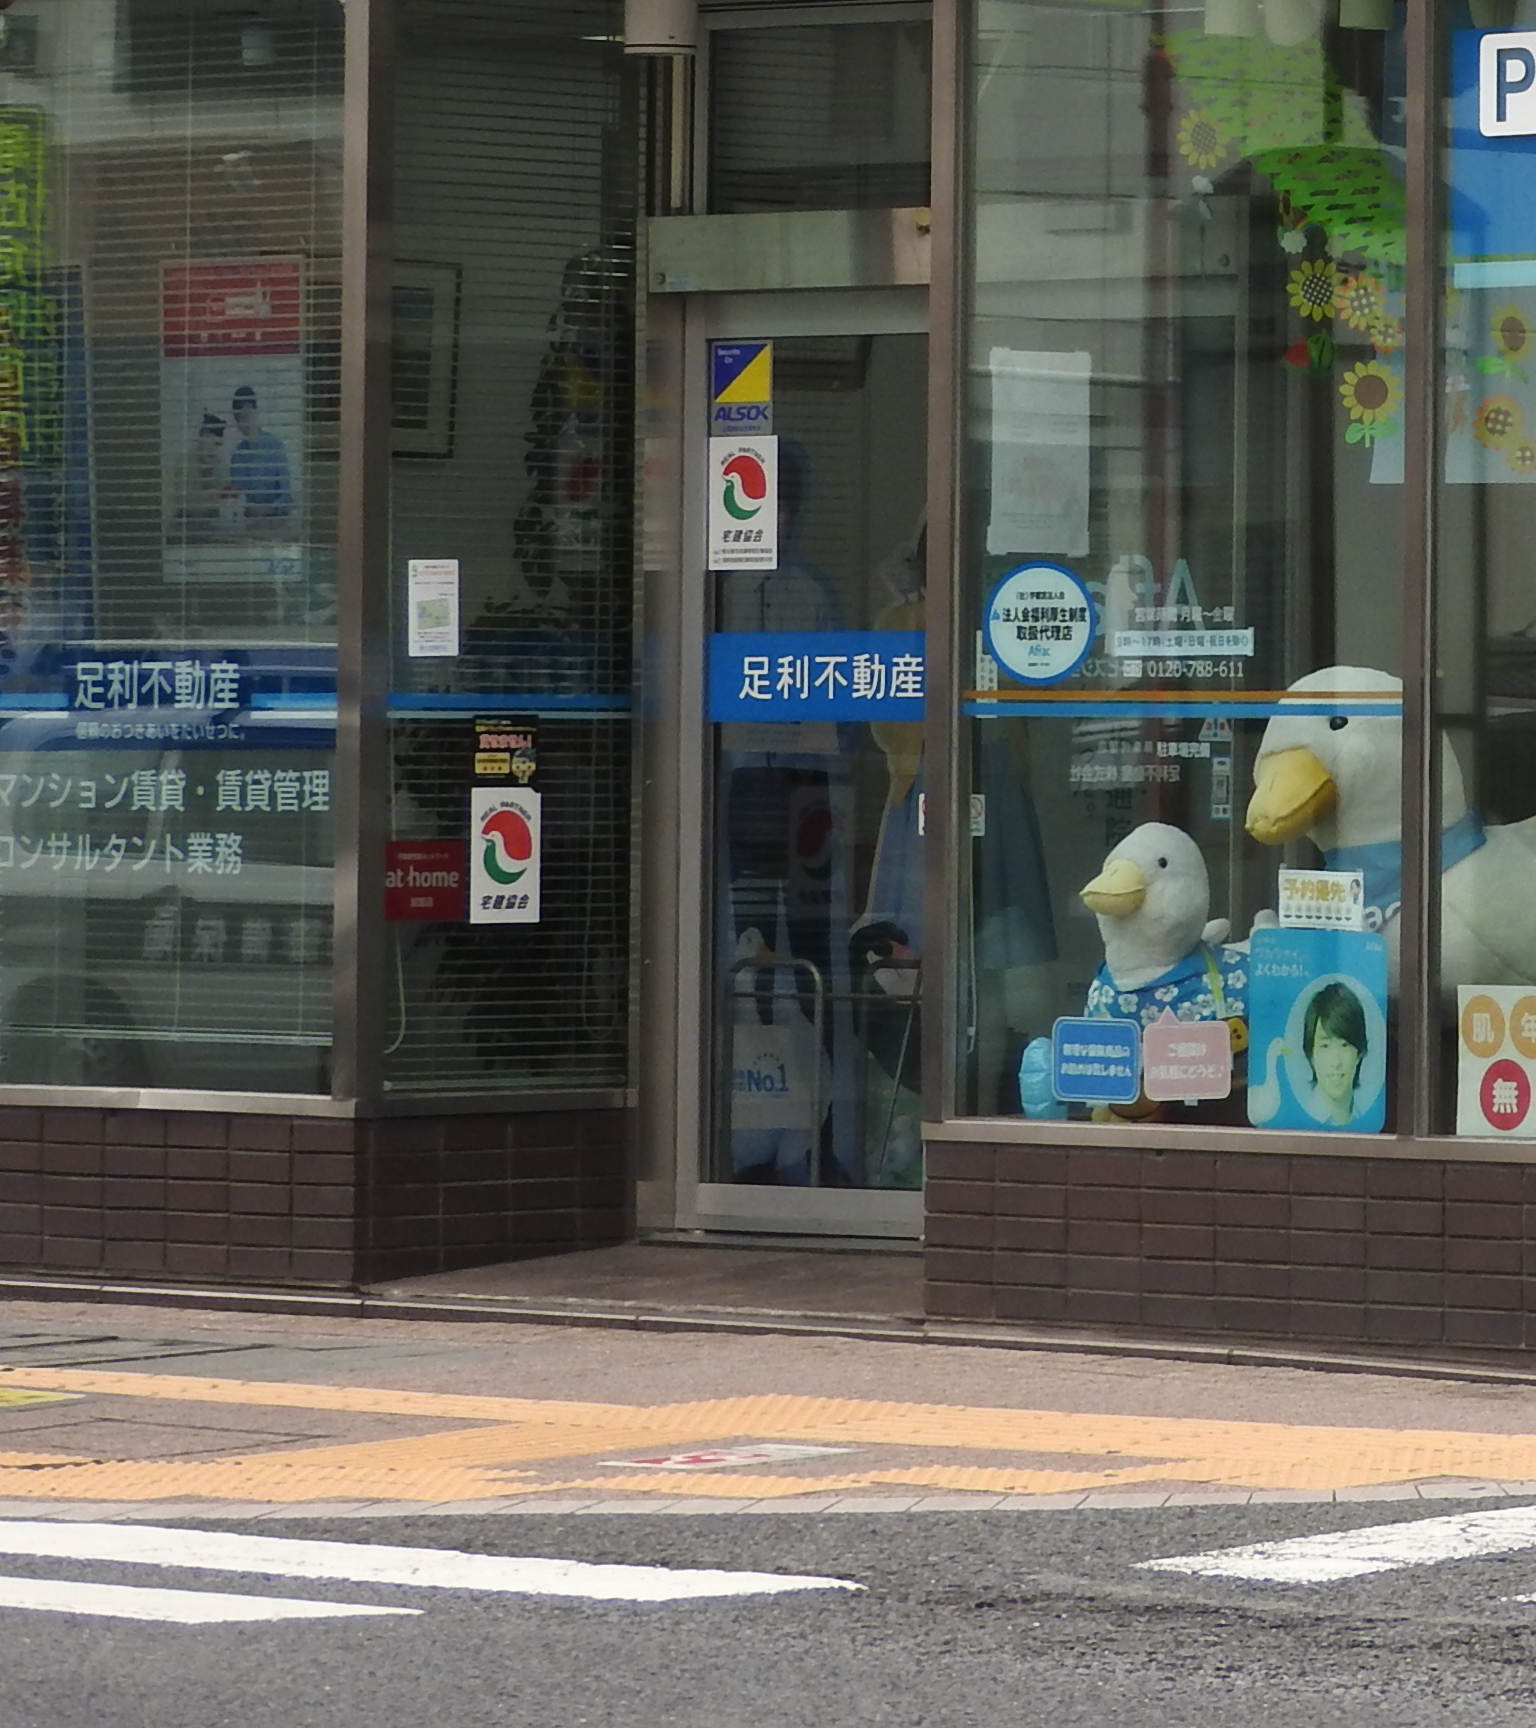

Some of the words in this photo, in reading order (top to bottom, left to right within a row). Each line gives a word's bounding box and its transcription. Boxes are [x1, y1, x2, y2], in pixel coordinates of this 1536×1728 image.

[1495, 46, 1536, 123] P
[714, 405, 769, 422] ALSOK
[1016, 625, 1073, 641] 取扱代理店
[739, 654, 925, 700] 足利不動産
[1147, 660, 1244, 679] 0120-788-611
[74, 659, 241, 710] 足利不動産
[385, 868, 404, 888] at
[406, 864, 460, 888] home
